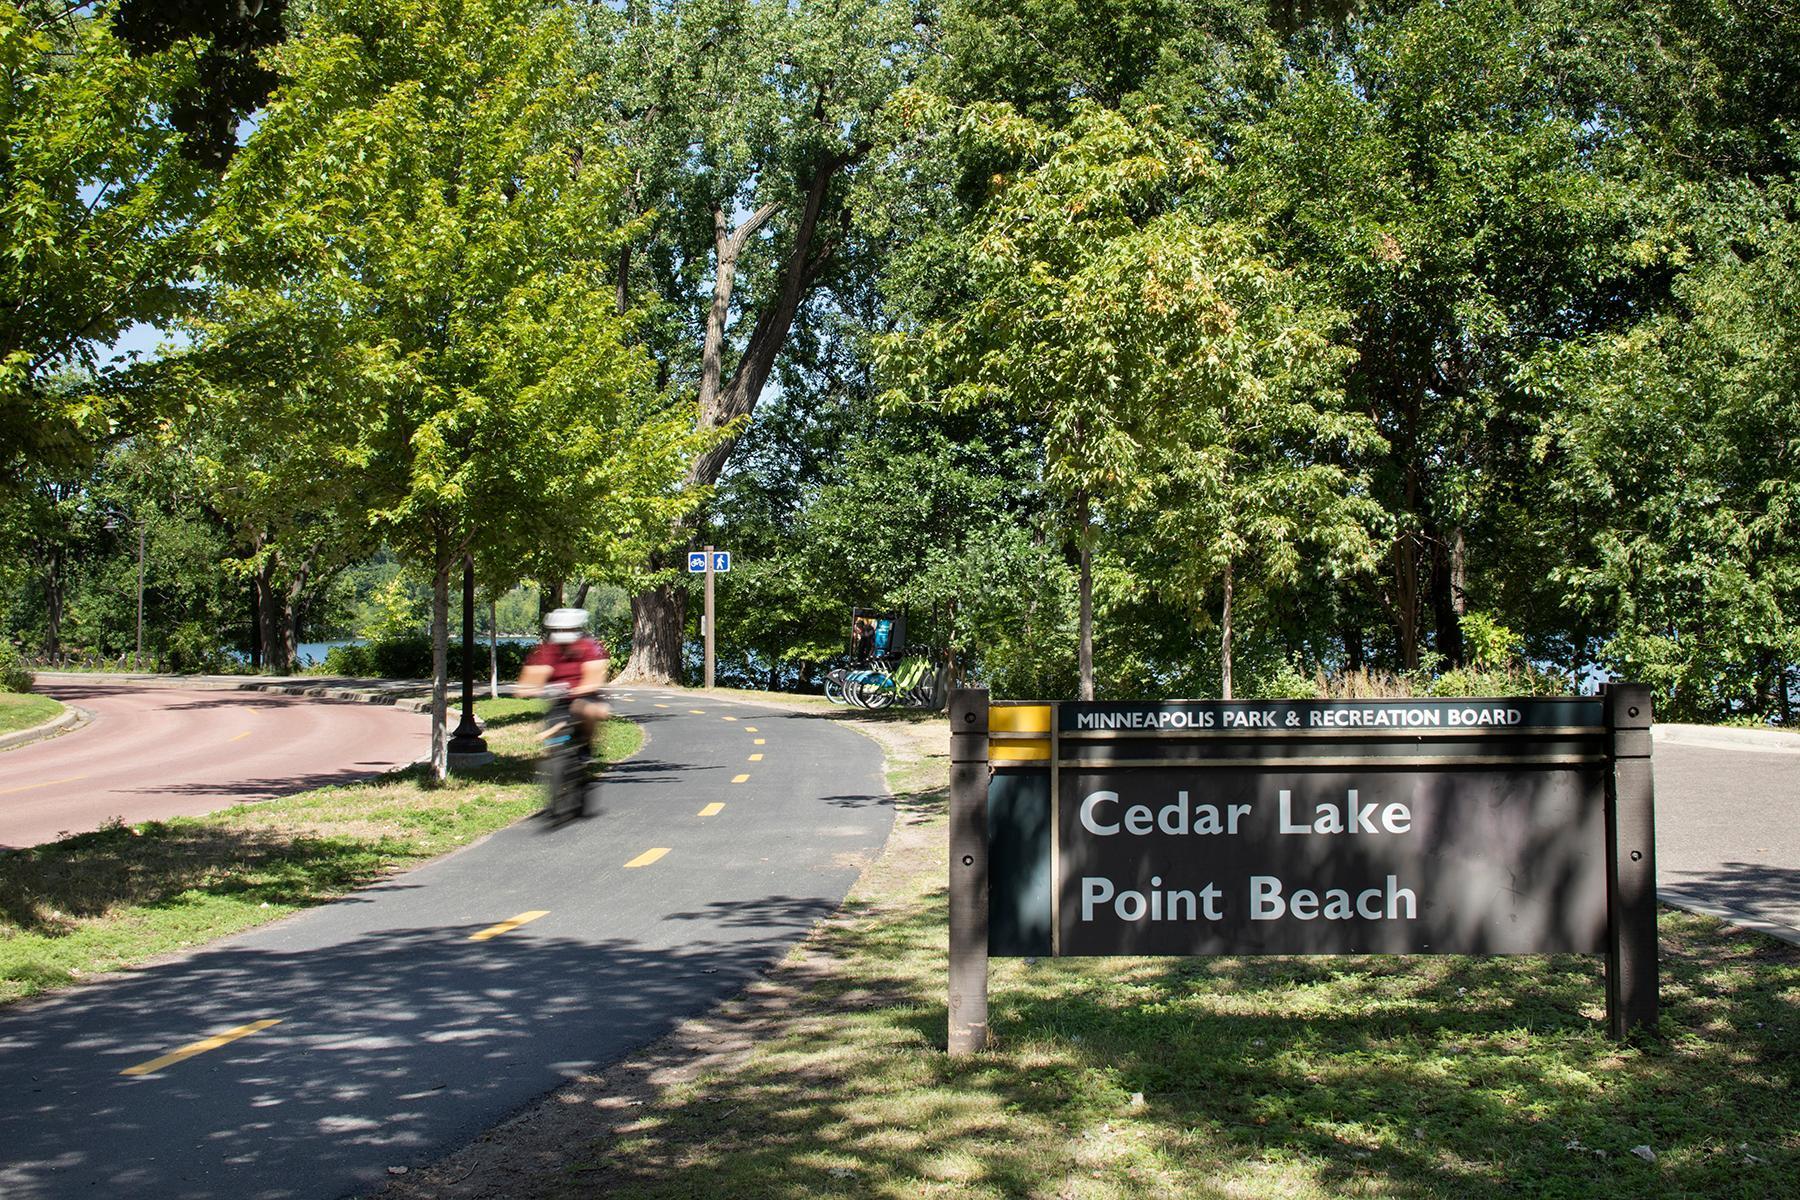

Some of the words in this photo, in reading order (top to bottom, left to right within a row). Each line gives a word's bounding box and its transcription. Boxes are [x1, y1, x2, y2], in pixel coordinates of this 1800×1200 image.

[1077, 711, 1215, 729] MINNEAPOLIS
[1223, 710, 1277, 728] PARK
[1284, 710, 1301, 727] &
[1309, 709, 1441, 727] RECREATION
[1448, 708, 1522, 726] BOARD
[1080, 790, 1252, 836] Cedar
[1279, 789, 1412, 835] Lake
[1081, 876, 1223, 922] Point
[1250, 874, 1417, 921] Beach
